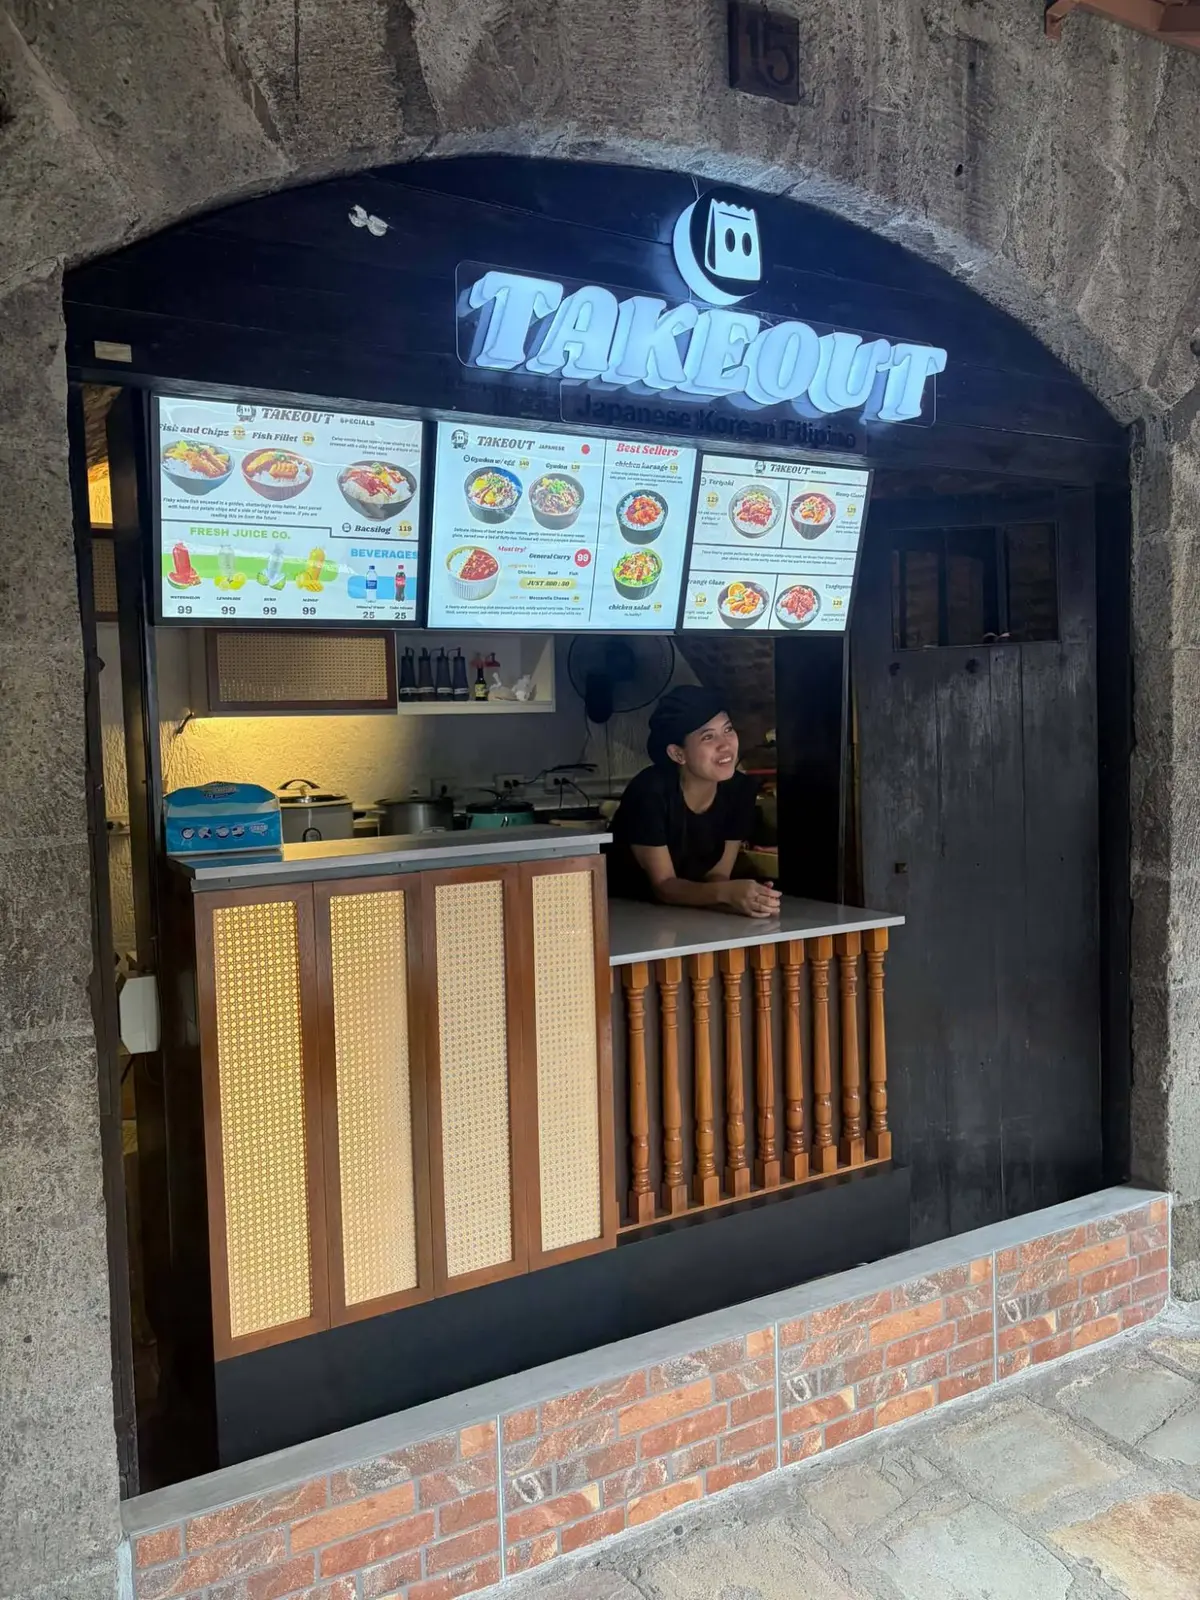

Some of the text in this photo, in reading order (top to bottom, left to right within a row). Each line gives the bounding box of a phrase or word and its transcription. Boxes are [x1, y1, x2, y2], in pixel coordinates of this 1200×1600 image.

[460, 270, 948, 423] TAKEOUT
[262, 407, 375, 427] TAKEOUT SPECIALS
[577, 393, 857, 450] Japanese Korean Filipino
[180, 426, 200, 434] and
[201, 427, 230, 438] Chips
[252, 431, 272, 441] Fish
[274, 433, 298, 442] Fillet
[477, 436, 535, 450] TAKEOUT
[616, 442, 679, 456] Best Sellers
[770, 463, 810, 475] TAKEOUT
[709, 479, 735, 487] Teriyaki
[190, 527, 291, 539] FRESH JUICE CO.
[354, 525, 391, 535] Bacsilog
[529, 552, 552, 560] General
[689, 579, 708, 587] range
[177, 605, 316, 615] 99 99 99 99
[362, 611, 375, 619] 25
